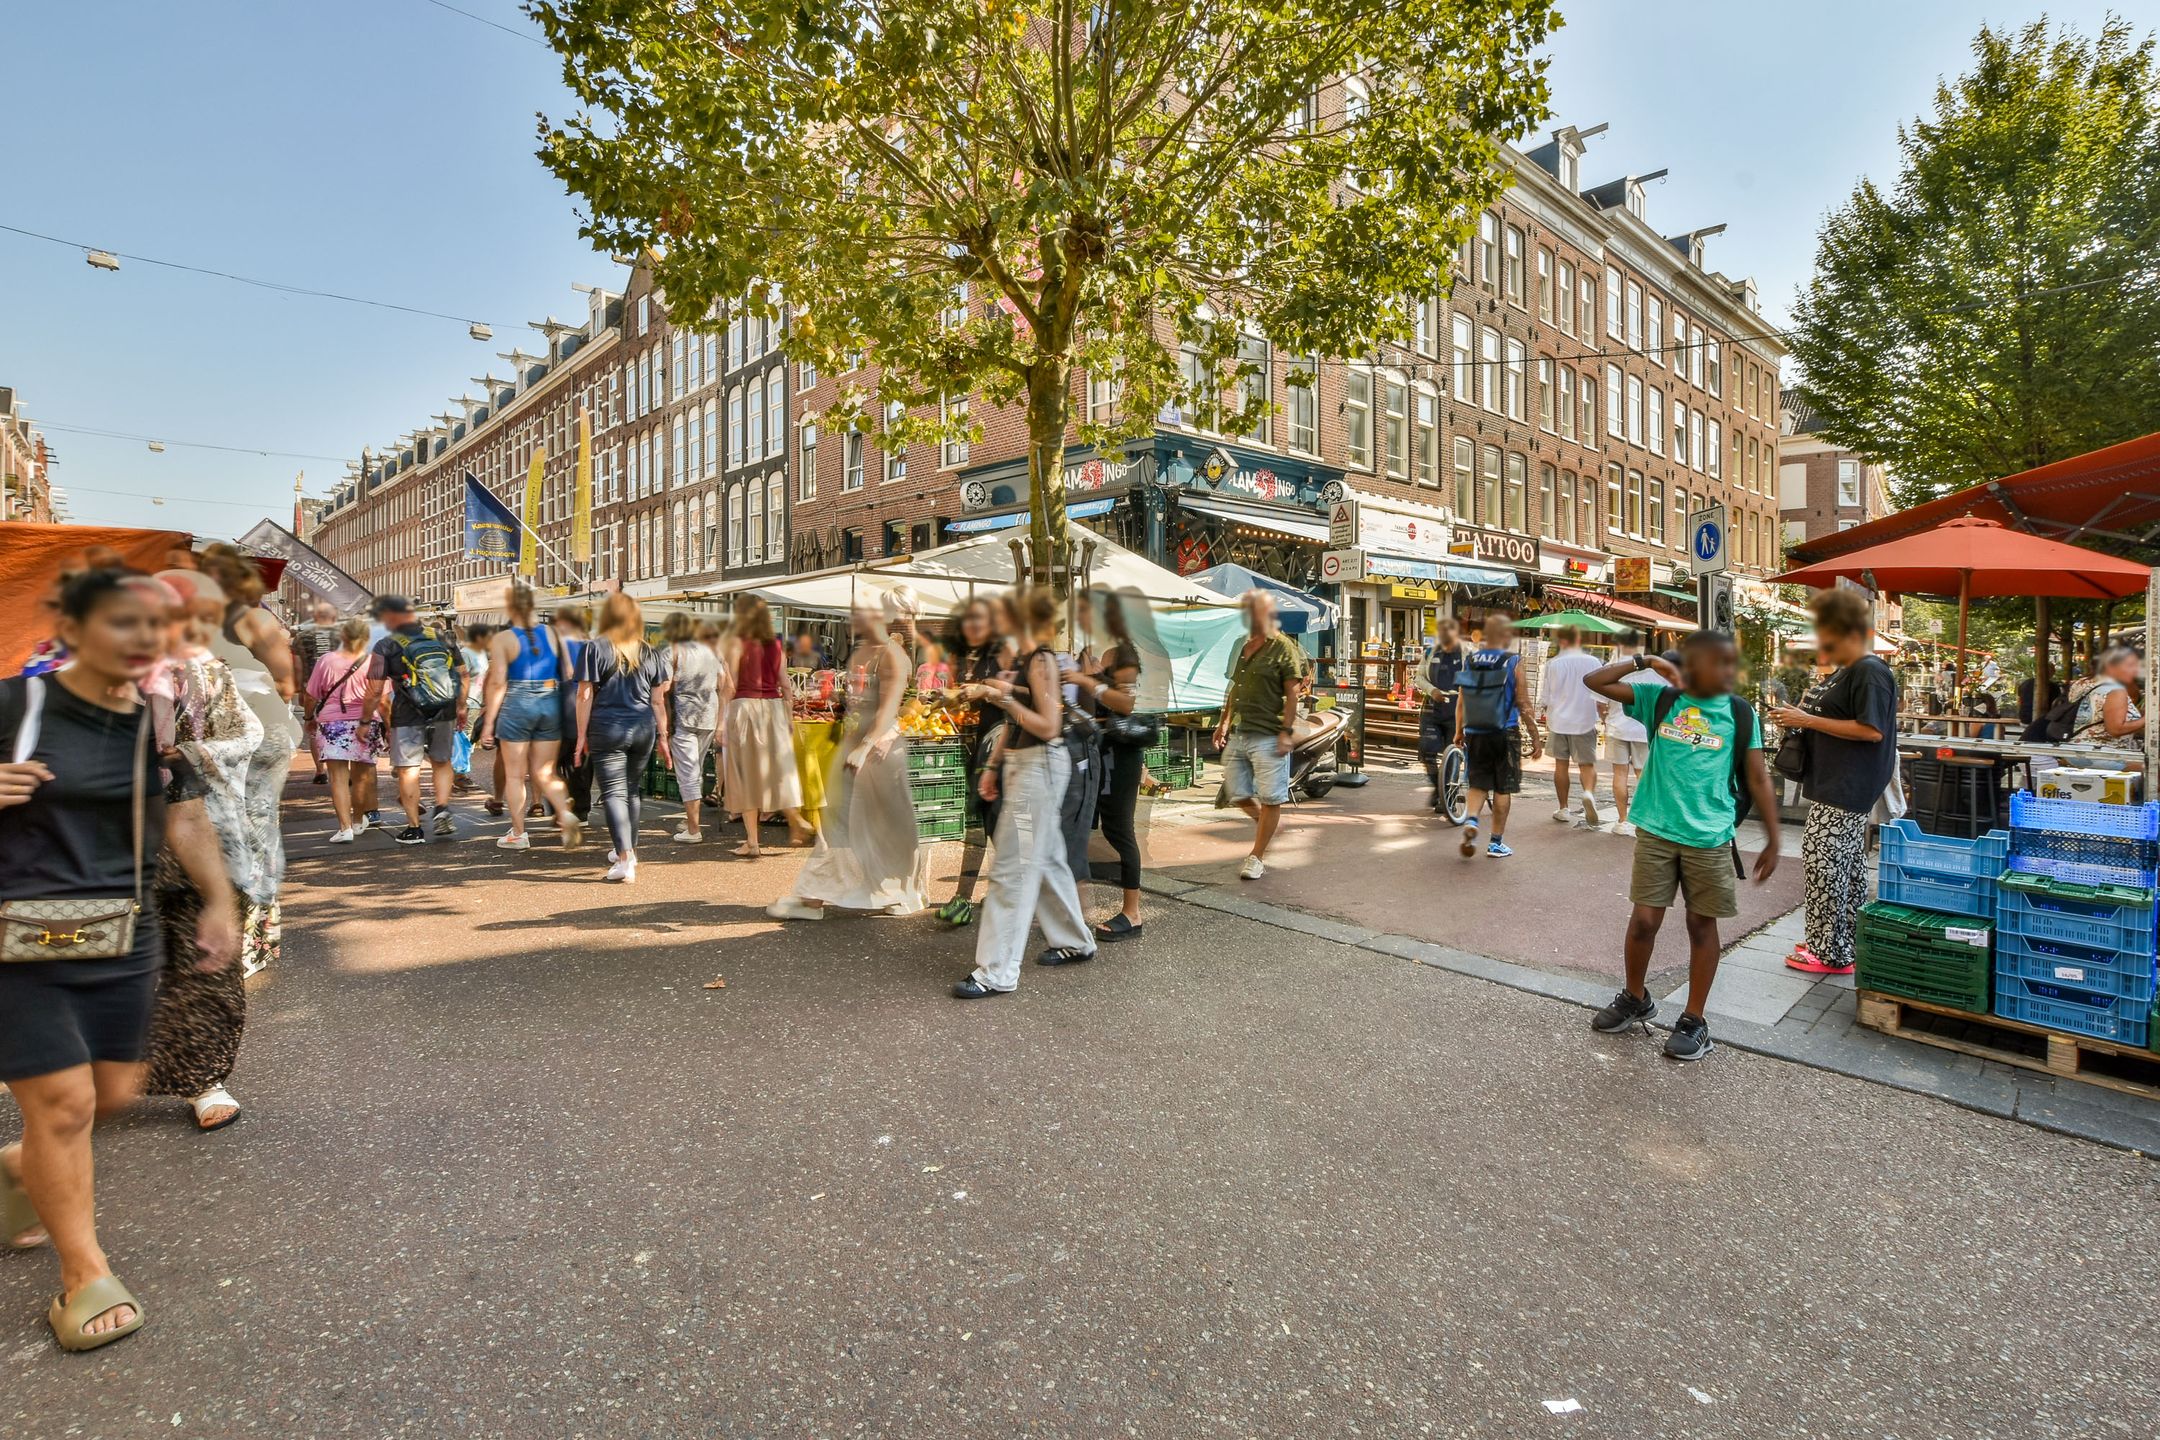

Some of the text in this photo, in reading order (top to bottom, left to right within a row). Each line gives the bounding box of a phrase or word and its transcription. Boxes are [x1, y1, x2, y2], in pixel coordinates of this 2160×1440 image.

[1064, 463, 1127, 490] AMINGO
[1698, 512, 1715, 522] ZONE
[1456, 529, 1535, 564] TATTOO
[1335, 692, 1358, 703] BAGELS
